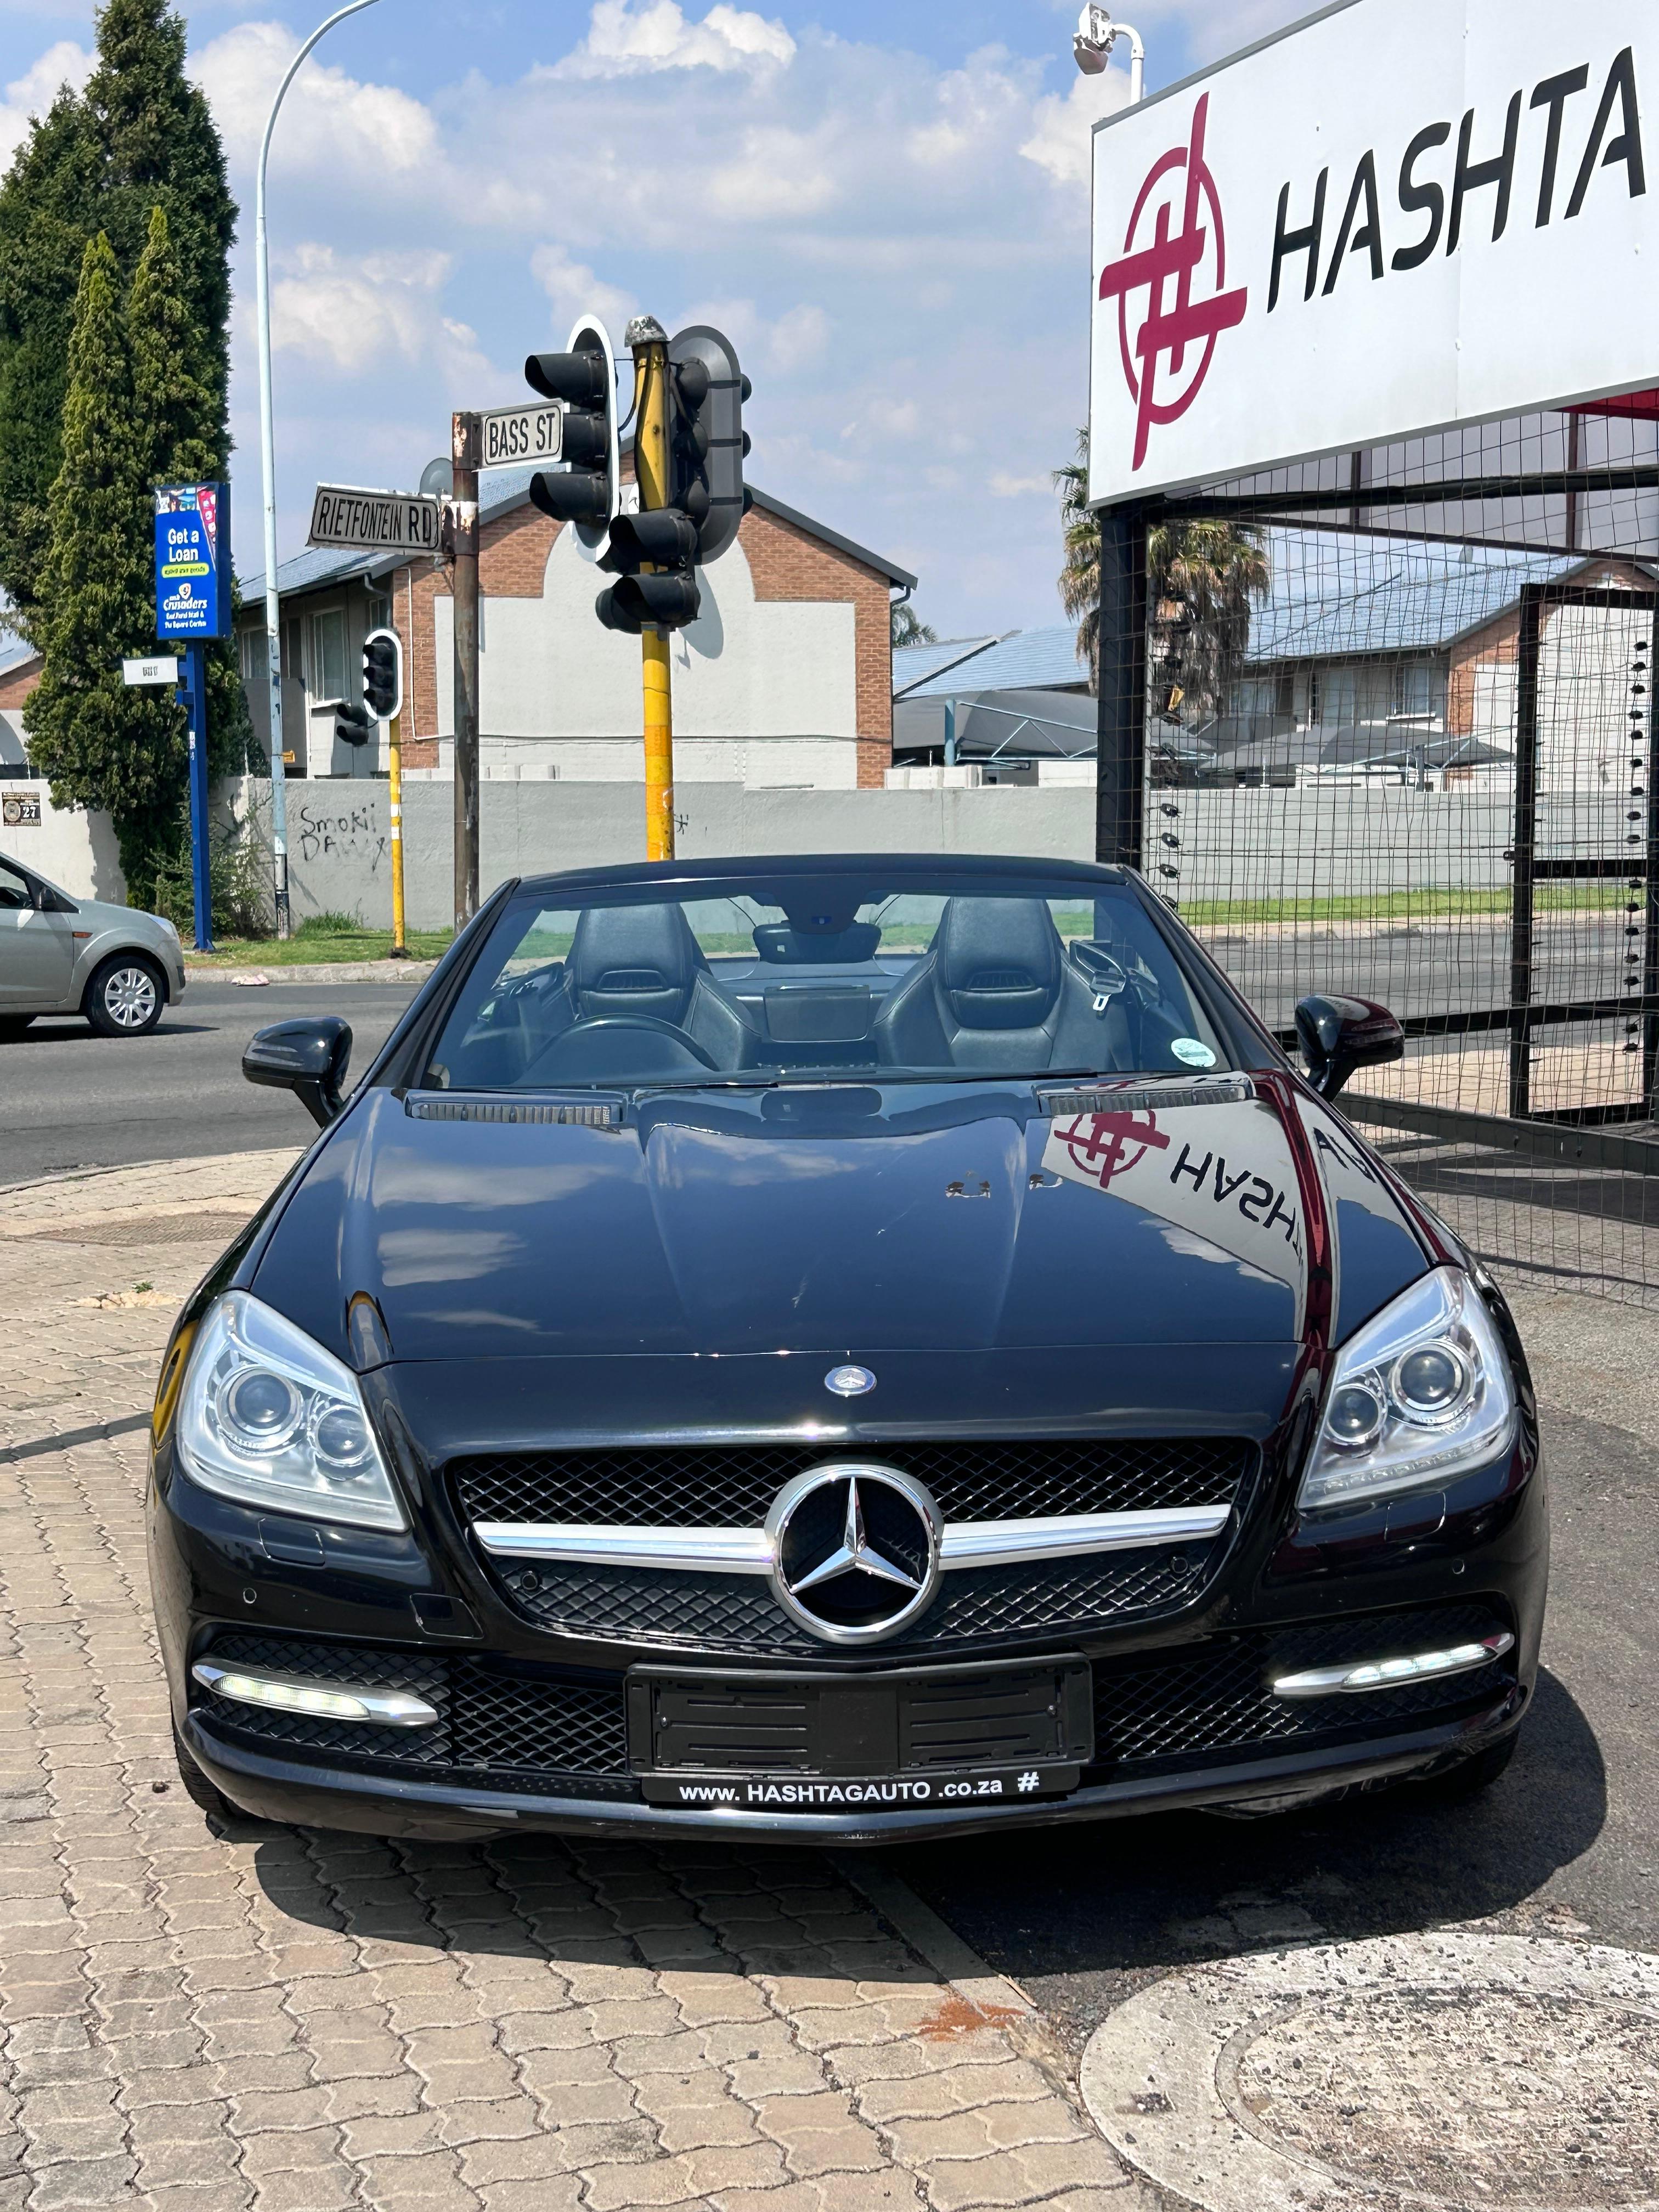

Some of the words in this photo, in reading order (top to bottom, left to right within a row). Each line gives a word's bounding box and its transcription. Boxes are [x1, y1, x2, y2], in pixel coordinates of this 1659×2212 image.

[1267, 46, 1646, 313] HASHTA
[489, 416, 528, 458] BASS
[536, 413, 555, 451] ST
[317, 496, 402, 541] RIETFONTEIN
[408, 505, 432, 543] RD
[168, 528, 188, 545] Get
[191, 531, 199, 543] a
[169, 546, 199, 562] Loan
[22, 806, 36, 818] 27
[679, 1786, 740, 1801] www.
[747, 1781, 931, 1802] HASHTAGAUTO
[938, 1779, 1003, 1798] .co.za
